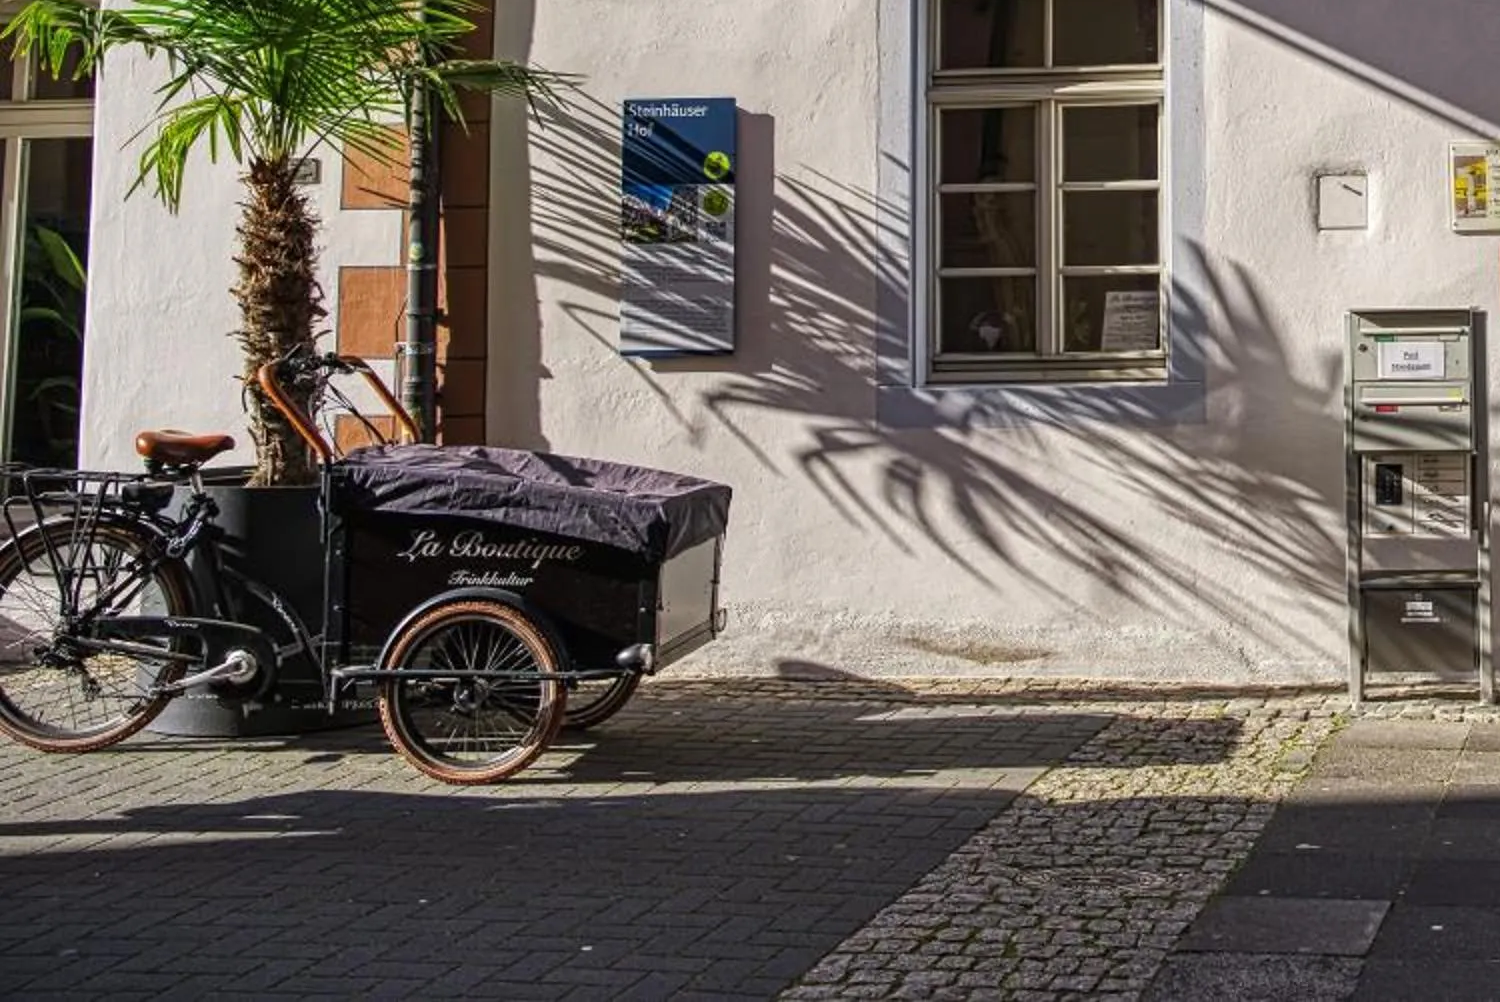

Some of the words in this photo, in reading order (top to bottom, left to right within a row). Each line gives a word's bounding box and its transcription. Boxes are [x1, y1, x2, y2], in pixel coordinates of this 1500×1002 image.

[629, 103, 708, 117] Steinhäuser
[627, 121, 655, 137] Hof
[396, 529, 445, 563] La
[449, 530, 584, 569] Boutique
[448, 570, 534, 587] Trinkkultur
